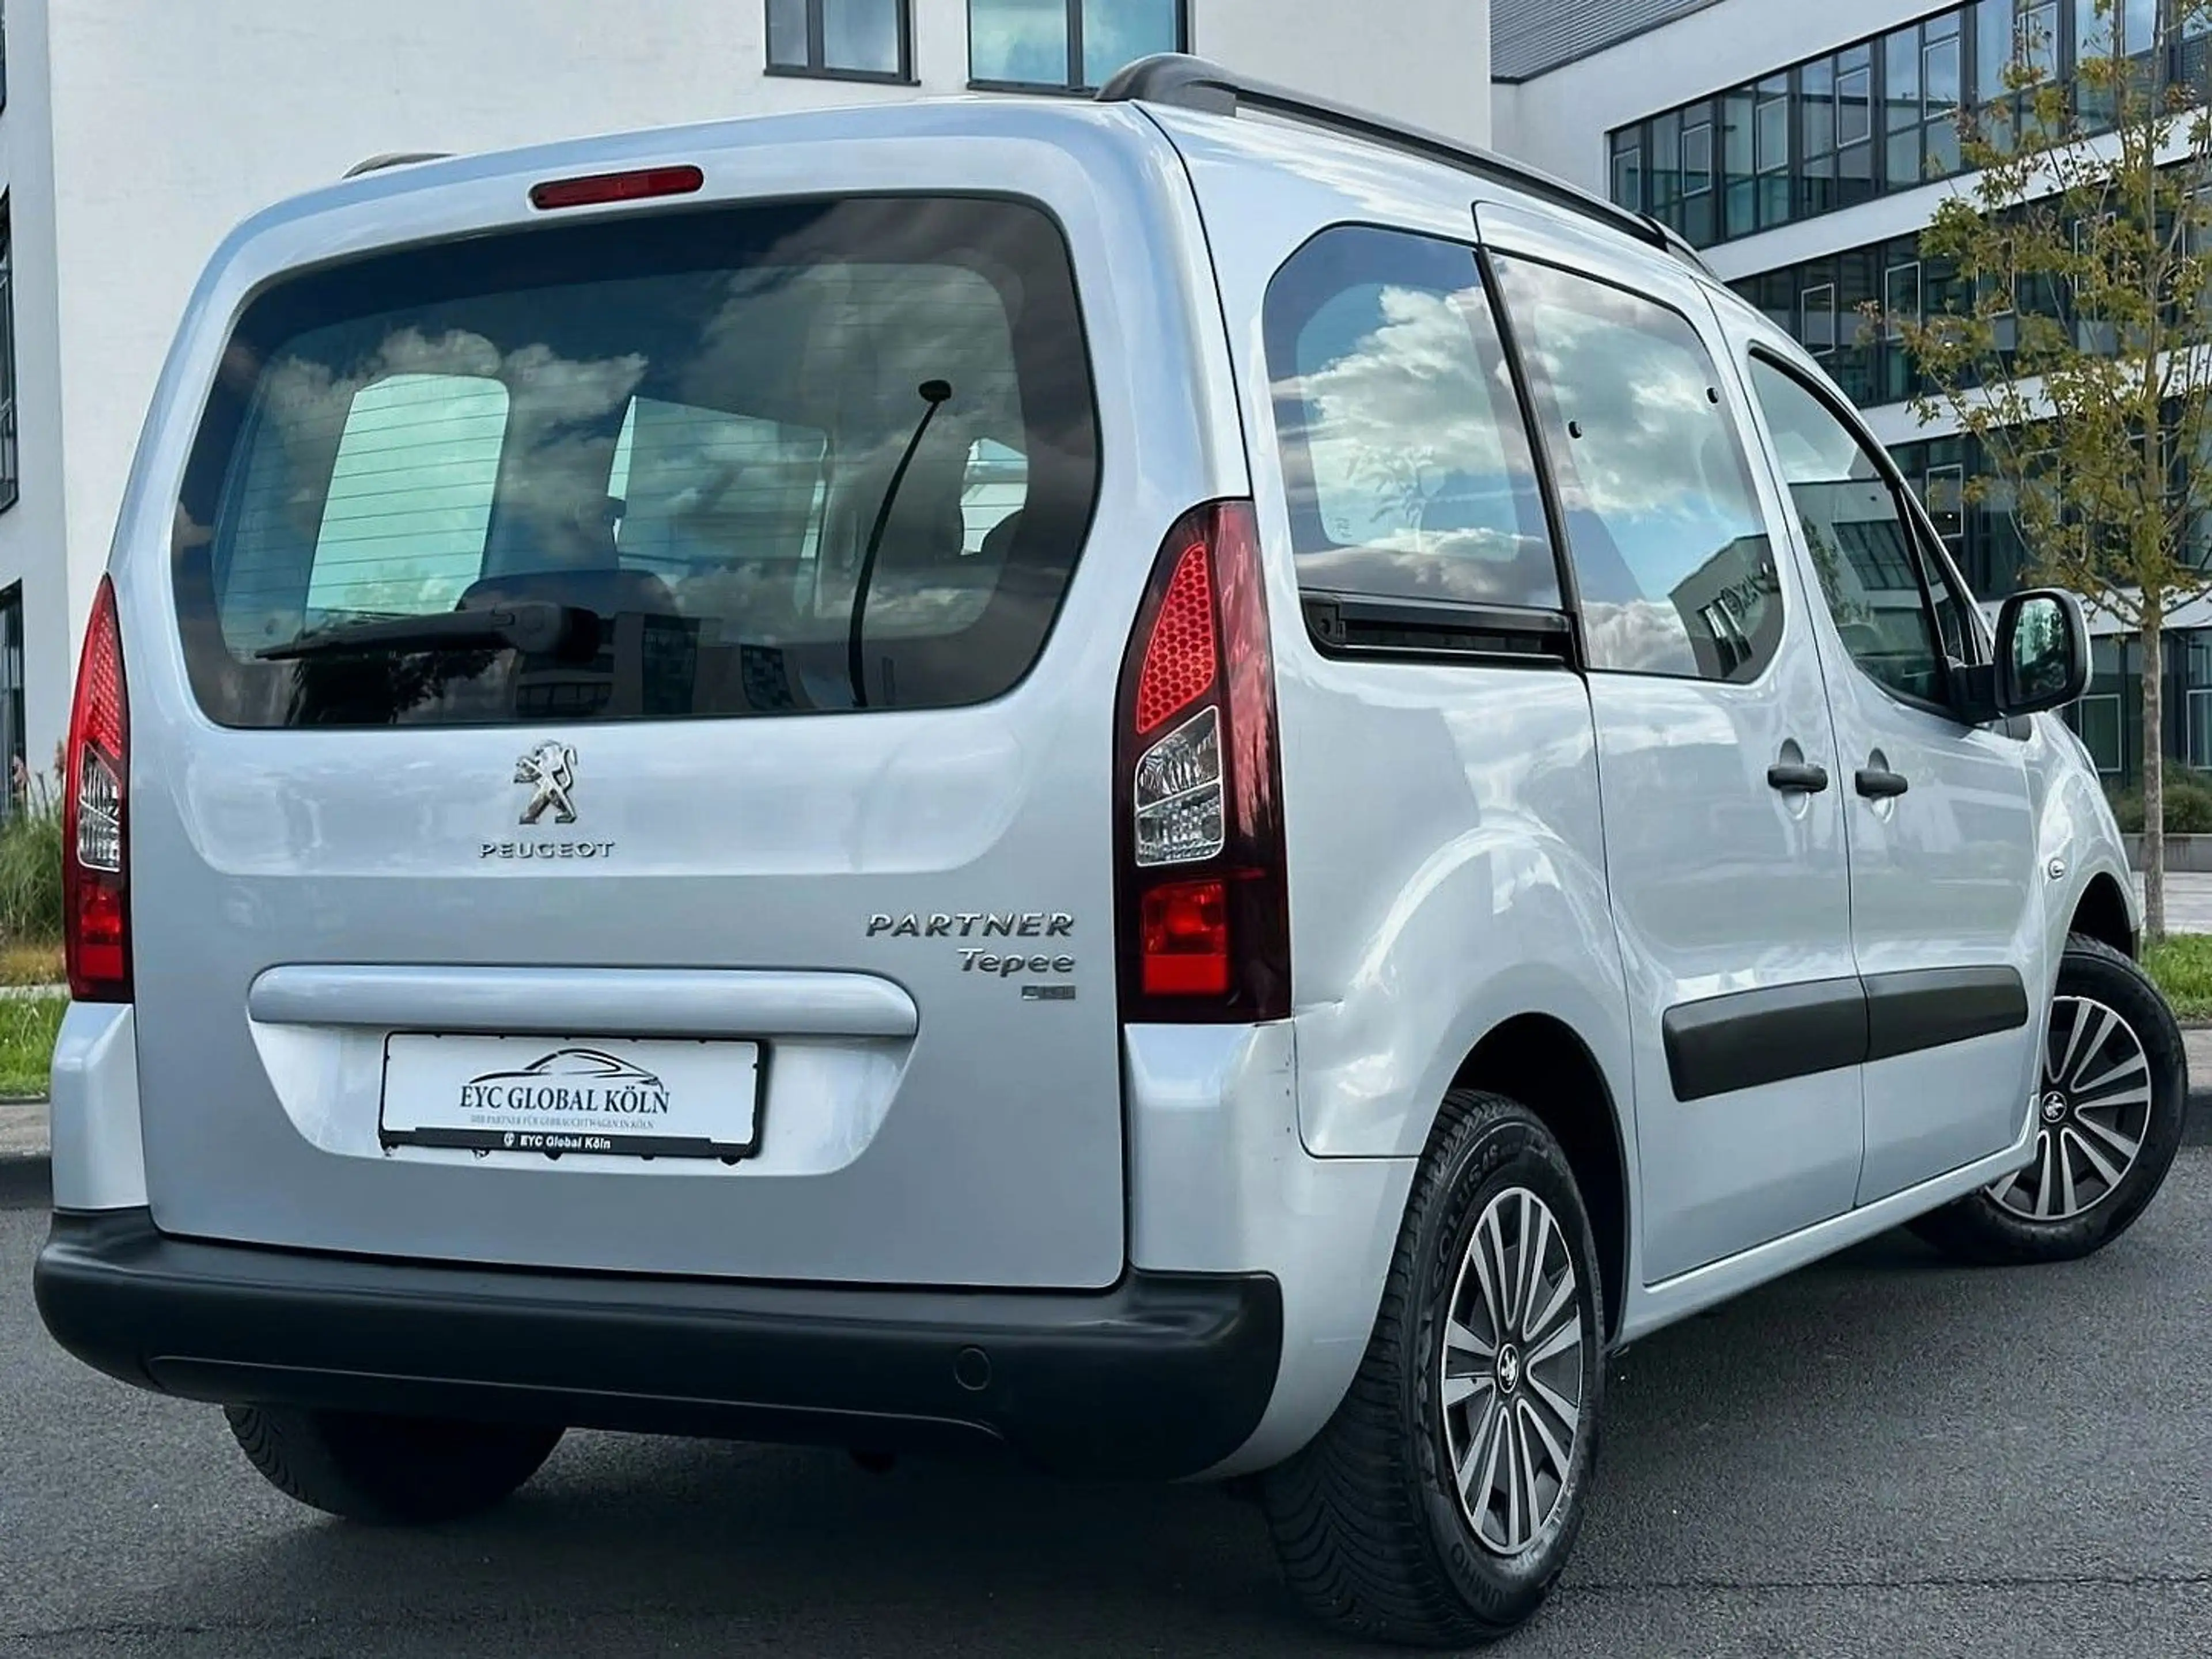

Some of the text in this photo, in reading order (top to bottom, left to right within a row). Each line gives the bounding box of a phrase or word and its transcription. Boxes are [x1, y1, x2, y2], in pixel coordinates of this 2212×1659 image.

[479, 841, 615, 858] PEUGEOT
[866, 912, 1075, 938] PARTNER
[956, 948, 1075, 978] Tepee
[460, 1085, 671, 1113] EYC GLOBAL KÖLN
[520, 1135, 611, 1149] EYC Global Köln
